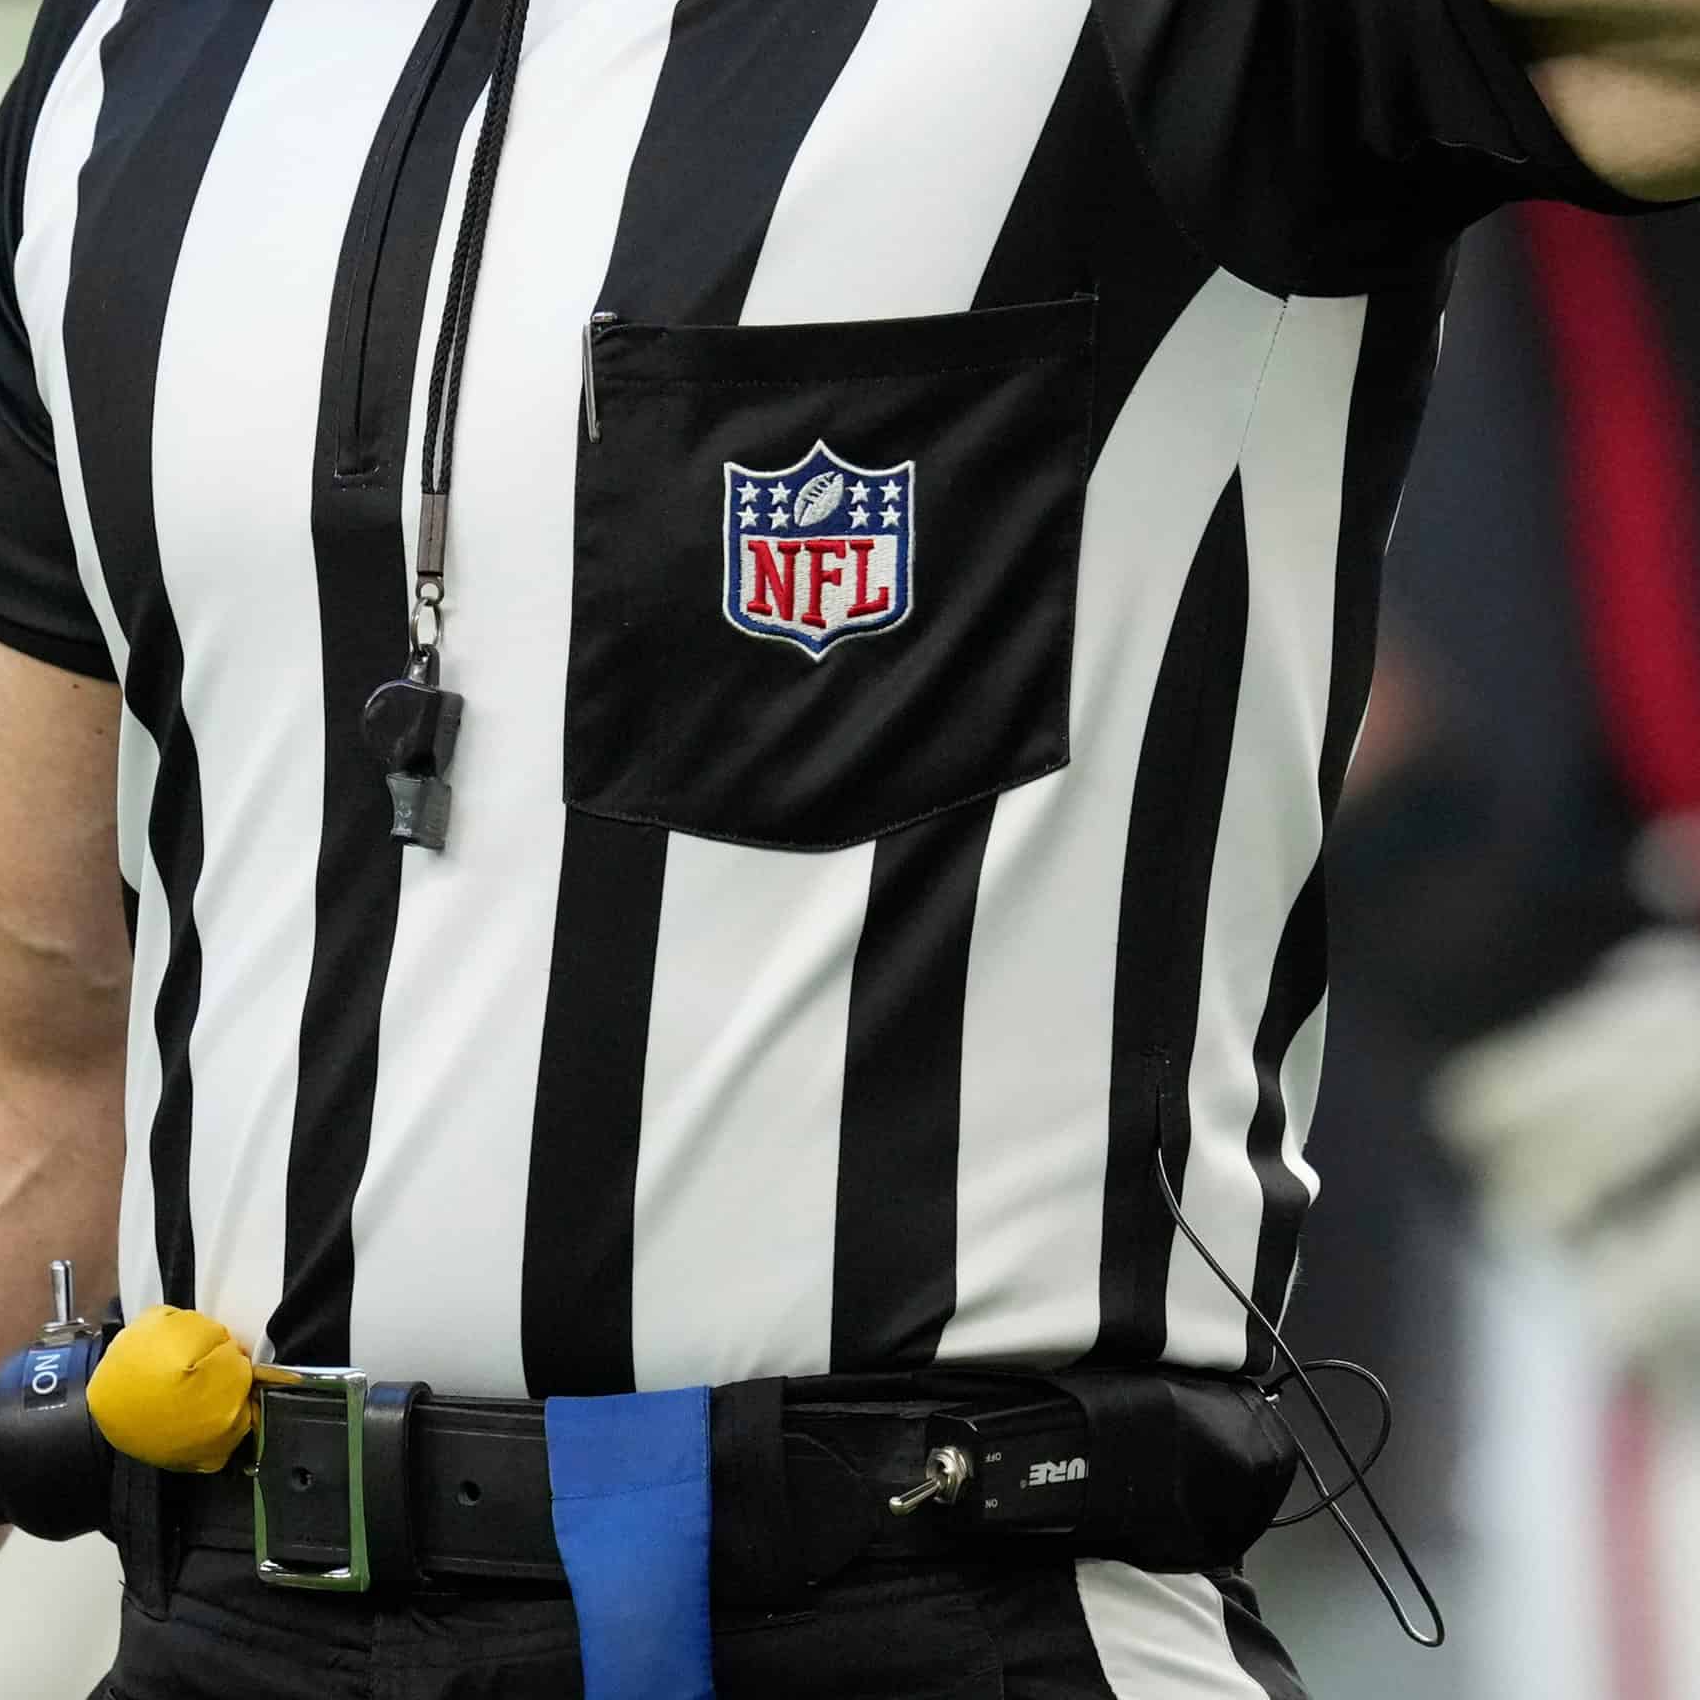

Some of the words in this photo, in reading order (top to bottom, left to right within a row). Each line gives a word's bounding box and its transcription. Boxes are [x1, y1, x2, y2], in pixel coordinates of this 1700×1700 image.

[746, 539, 890, 629] NFL
[32, 1354, 61, 1394] ON
[1028, 1457, 1089, 1486] URE
[985, 1498, 998, 1509] ON
